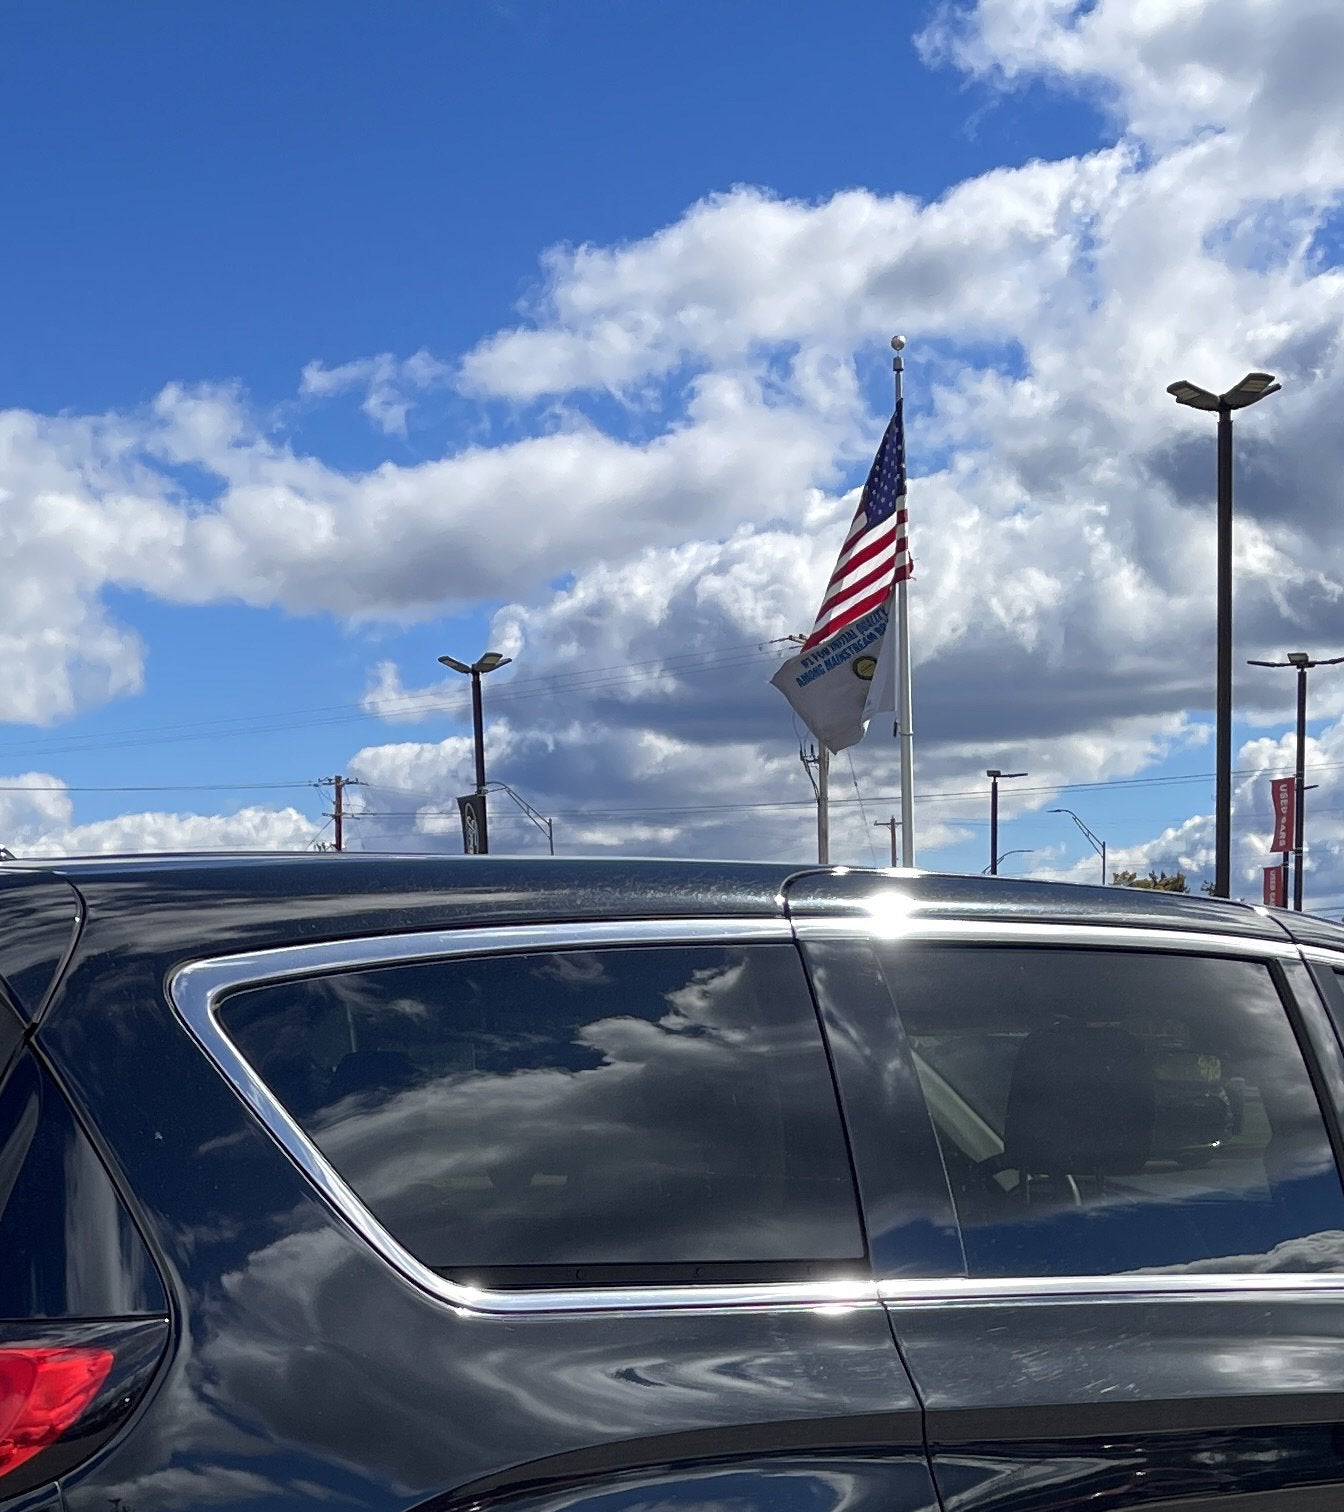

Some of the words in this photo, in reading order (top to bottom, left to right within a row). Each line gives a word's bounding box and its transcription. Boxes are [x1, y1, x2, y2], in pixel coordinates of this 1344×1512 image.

[796, 665, 825, 688] AMONG
[823, 633, 878, 670] MAINSTREAM
[1280, 784, 1288, 814] USED
